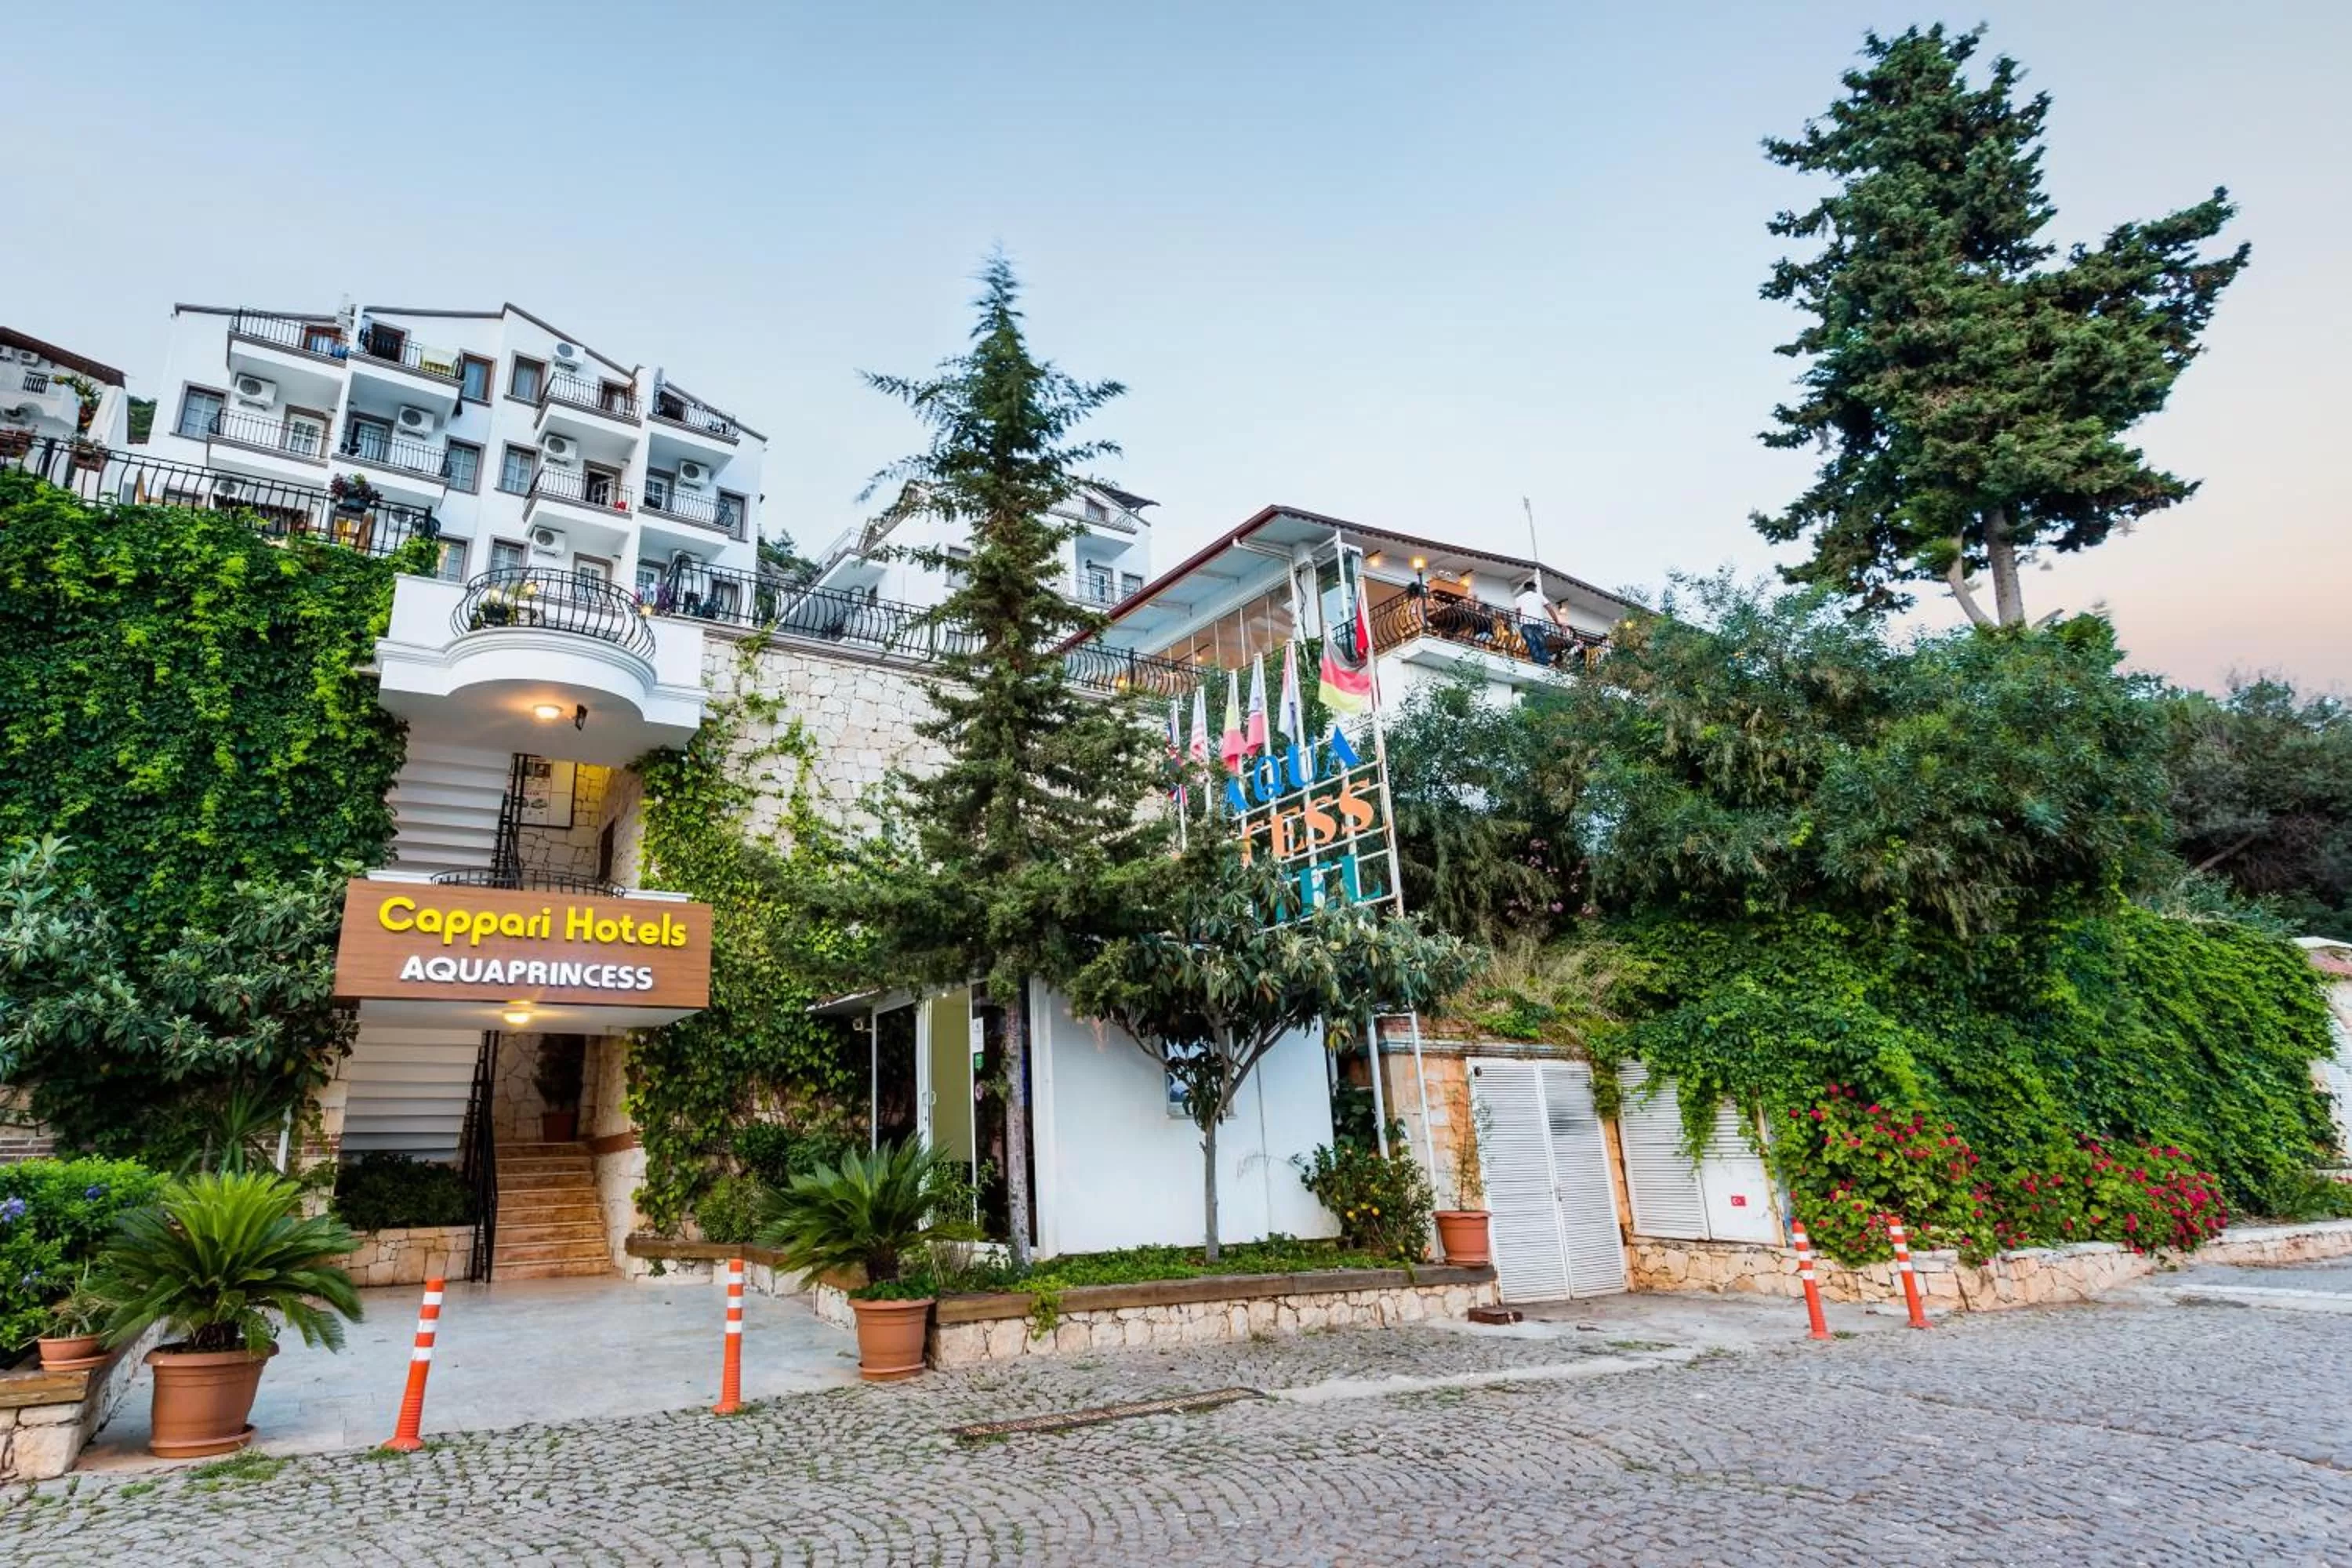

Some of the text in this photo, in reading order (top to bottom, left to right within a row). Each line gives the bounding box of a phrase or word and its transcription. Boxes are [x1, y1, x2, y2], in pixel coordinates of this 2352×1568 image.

[1221, 724, 1361, 817] AQUA
[378, 896, 688, 947] Cappari Hotels
[399, 955, 654, 991] AQUAPRINCESS
